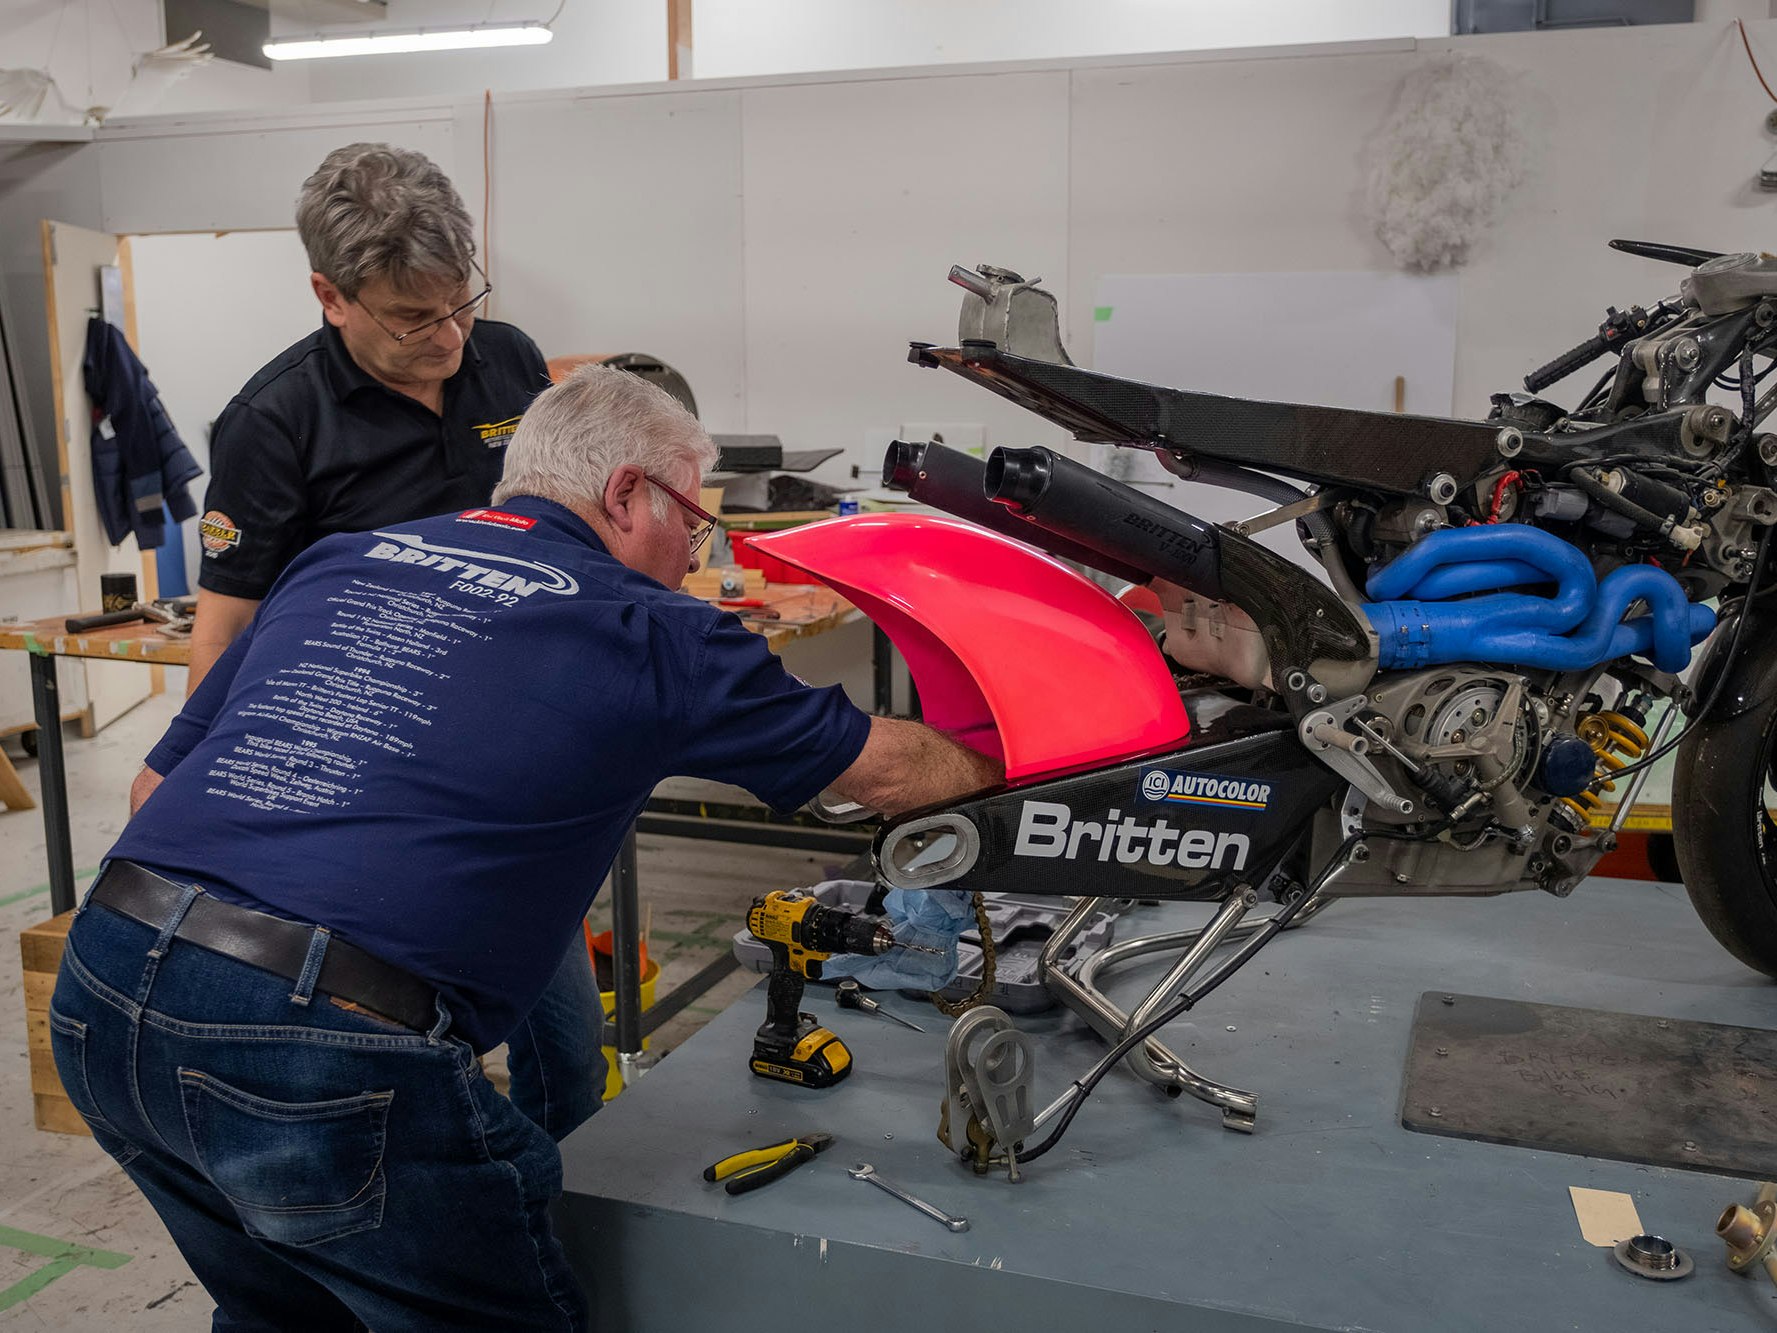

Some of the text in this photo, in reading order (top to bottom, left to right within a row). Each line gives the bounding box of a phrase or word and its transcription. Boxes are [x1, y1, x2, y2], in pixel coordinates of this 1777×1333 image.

[481, 424, 518, 439] BRITTE
[1122, 512, 1203, 554] BRITTEN
[364, 542, 543, 598] BRITTEN
[402, 598, 420, 610] Series
[449, 580, 520, 609] F002-92
[346, 598, 366, 608] Grand
[365, 602, 377, 611] Prix
[450, 622, 479, 638] Raceway
[330, 630, 361, 640] Australian
[361, 634, 370, 642] TT
[356, 640, 381, 652] Formula
[365, 627, 382, 636] Twins
[386, 633, 405, 643] Assen
[405, 638, 430, 650] Holland
[434, 647, 448, 656] 3rd
[413, 631, 425, 640] NZ
[304, 639, 322, 647] BEARS
[322, 641, 342, 650] Sound
[350, 645, 374, 657] Thunder
[379, 653, 406, 666] Ruapuna
[406, 661, 434, 676] Raceway
[384, 661, 396, 669] NZ
[308, 663, 334, 672] National
[333, 667, 363, 680] Superbike
[363, 675, 408, 694] Championship
[354, 666, 371, 676] 1994
[295, 690, 313, 699] North
[314, 693, 329, 702] West
[346, 702, 370, 714] Ireland
[314, 671, 336, 680] Grand
[334, 676, 346, 684] Prix
[347, 679, 360, 688] Title
[365, 684, 392, 697] Ruapuna
[392, 692, 421, 708] Raceway
[363, 690, 375, 698] NZ
[299, 705, 325, 717] Daytona
[308, 702, 324, 710] Twins
[329, 706, 355, 718] Daytona
[355, 713, 383, 726] Raceway
[335, 691, 357, 701] Fastest
[356, 696, 368, 705] Lap
[368, 699, 390, 710] Senior
[390, 705, 400, 713] TT
[403, 711, 432, 727] 119mph
[279, 715, 321, 732] Championship
[349, 732, 373, 743] RNZAF
[371, 738, 383, 746] Air
[383, 742, 400, 753] Base
[286, 709, 305, 717] speed
[318, 716, 345, 727] recorded
[352, 724, 379, 737] Daytona
[385, 734, 414, 749] 189mph
[259, 742, 273, 750] bike
[274, 740, 294, 750] BEARS
[301, 739, 318, 748] 1995
[216, 757, 236, 765] BEARS
[271, 765, 292, 777] Round
[233, 746, 254, 756] BEARS
[288, 756, 309, 767] Round
[320, 763, 346, 776] Thruxton
[285, 760, 297, 769] UK
[206, 787, 227, 797] BEARS
[208, 769, 228, 778] BEARS
[228, 771, 247, 781] World
[267, 781, 289, 792] Round
[316, 795, 336, 806] Hatch
[230, 778, 320, 808] World Support Event
[250, 766, 270, 777] Speed
[313, 785, 336, 796] Austria
[1148, 774, 1271, 803] ICI AUTOCOLOR
[1013, 799, 1250, 871] Britten
